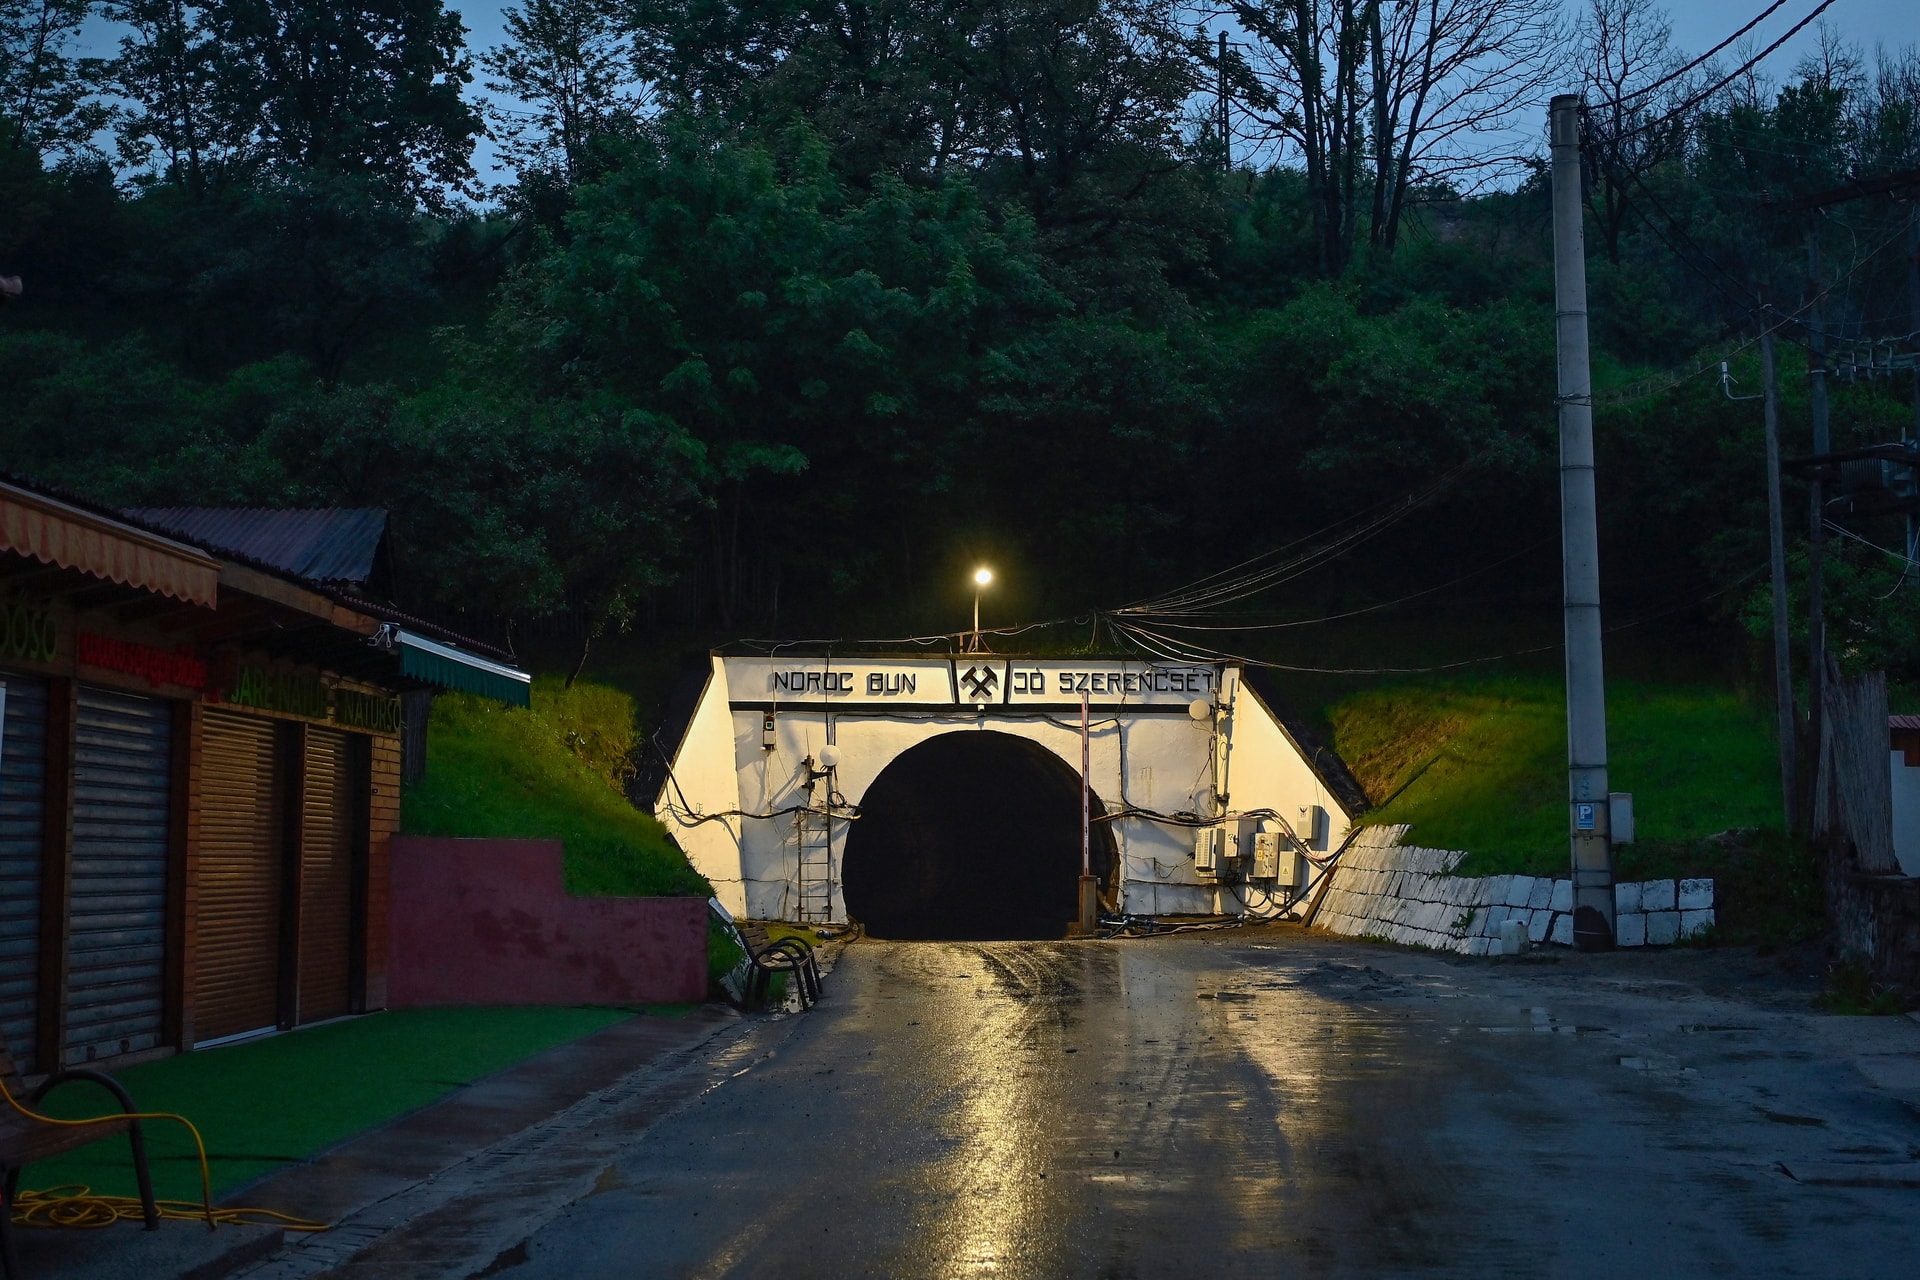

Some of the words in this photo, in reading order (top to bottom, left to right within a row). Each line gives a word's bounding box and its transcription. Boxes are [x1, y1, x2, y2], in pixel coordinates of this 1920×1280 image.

[774, 671, 854, 692] NOROC
[870, 672, 916, 692] BUN
[1580, 805, 1592, 820] P
